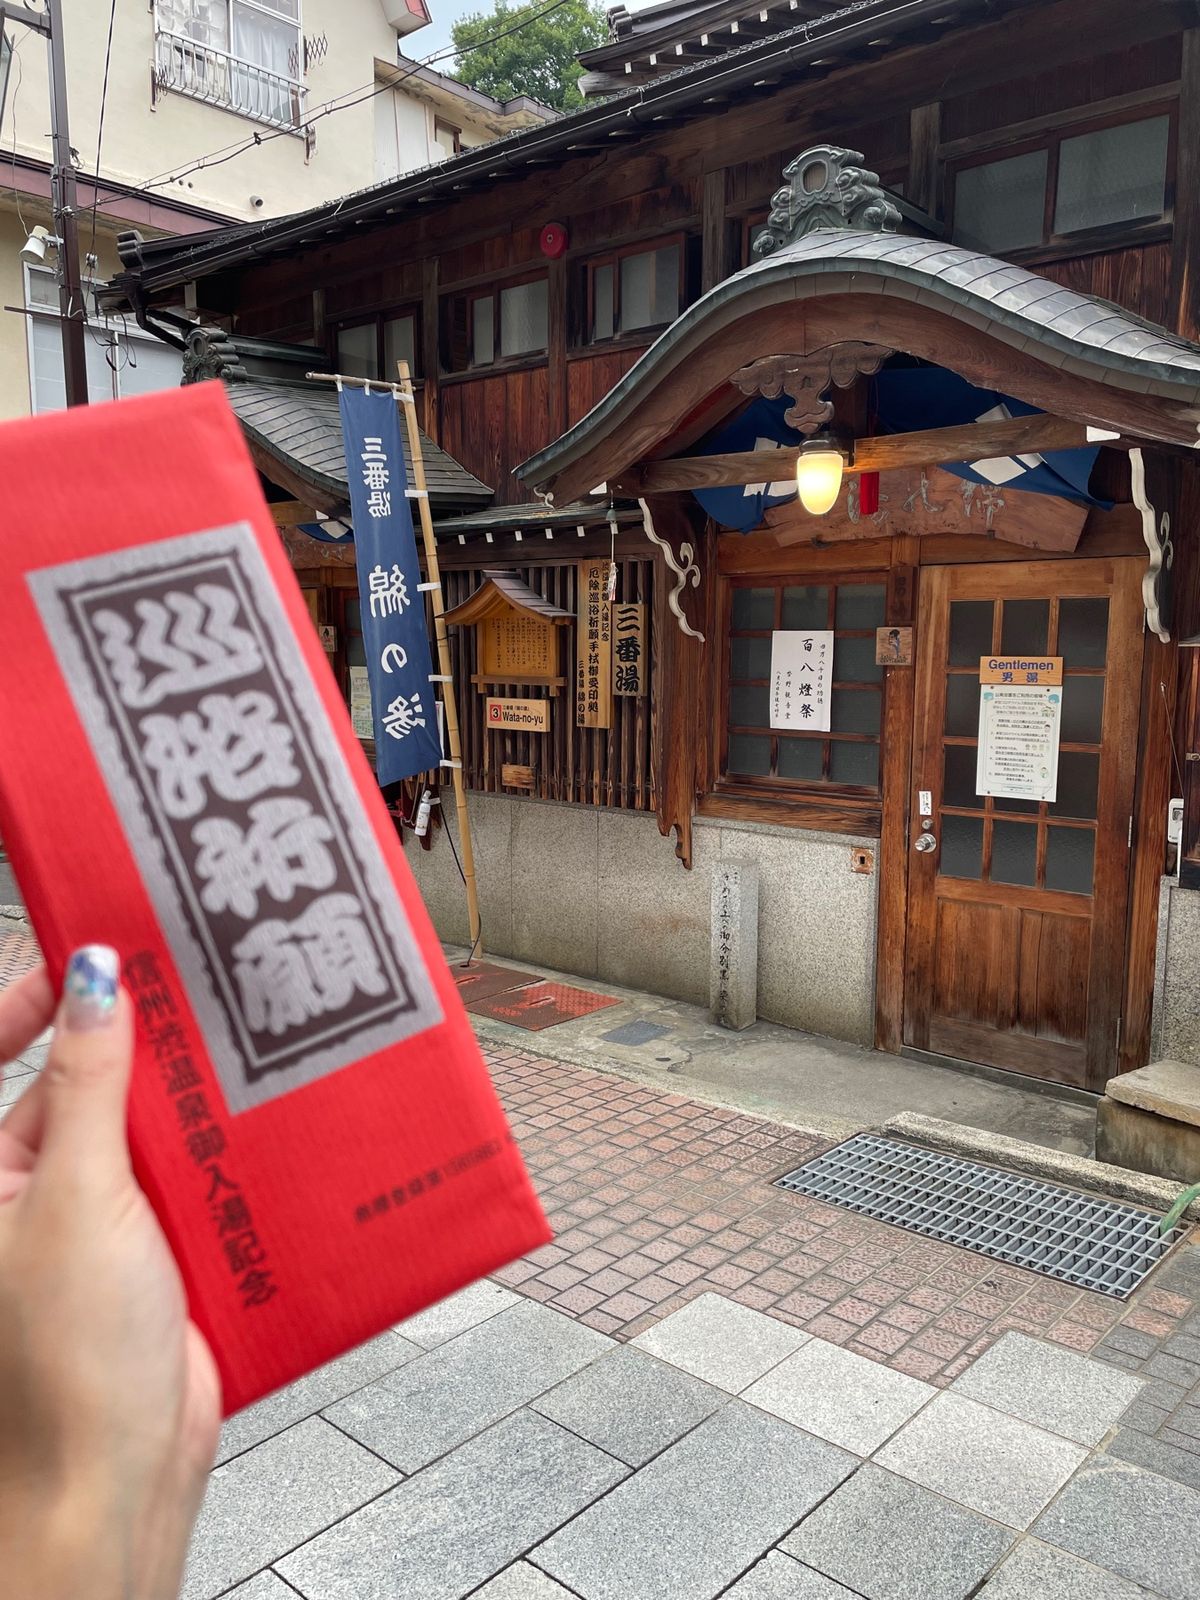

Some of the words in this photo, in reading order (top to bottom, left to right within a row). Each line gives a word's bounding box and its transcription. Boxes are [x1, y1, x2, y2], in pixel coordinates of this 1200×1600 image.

[615, 607, 641, 693] 三番湯
[988, 659, 1054, 671] Gentlemen
[492, 707, 499, 719] 3
[502, 711, 544, 726] Wata-no-yu
[91, 584, 391, 1037] 巡浴祈願
